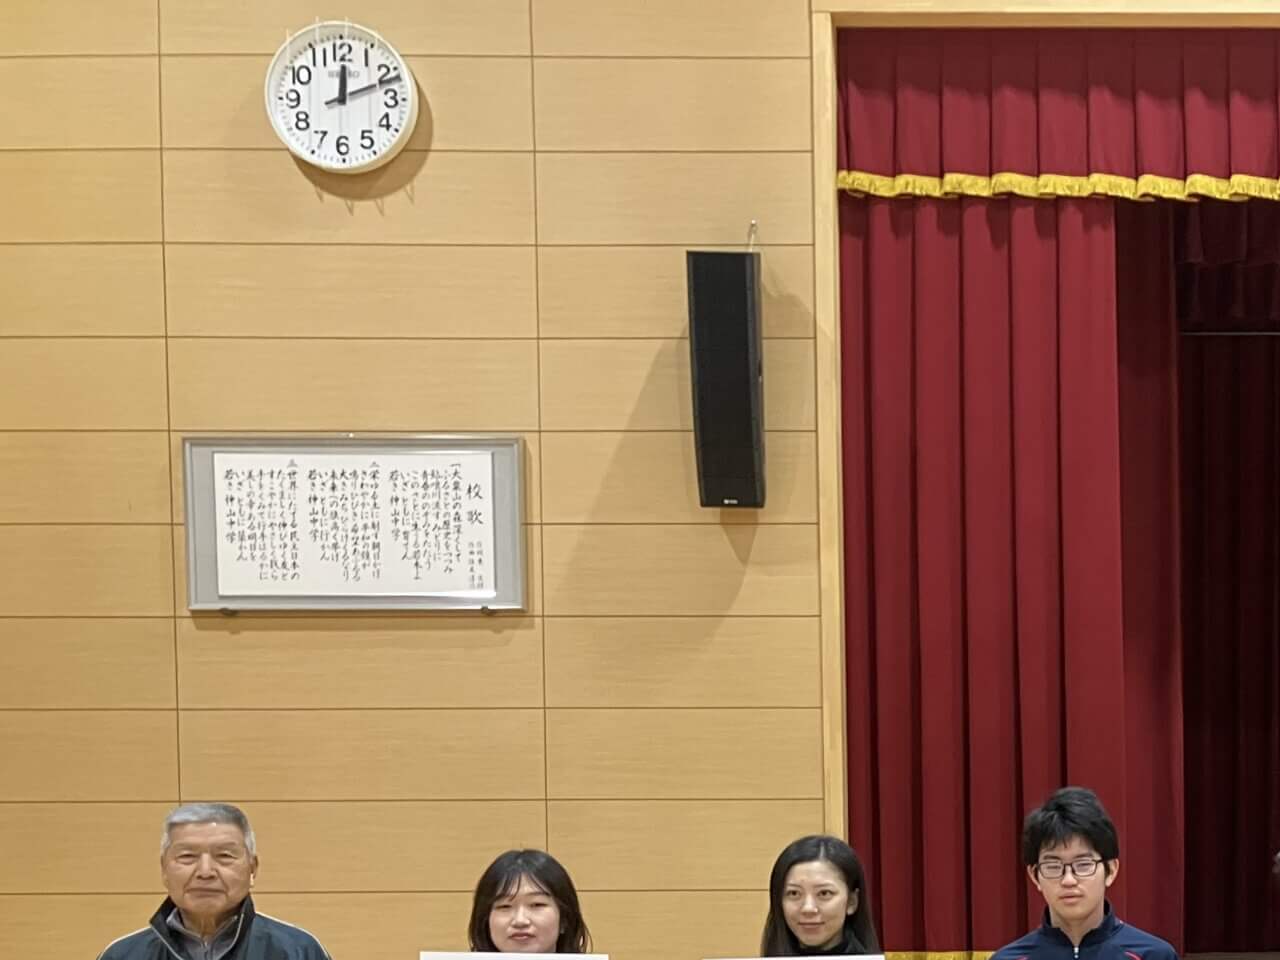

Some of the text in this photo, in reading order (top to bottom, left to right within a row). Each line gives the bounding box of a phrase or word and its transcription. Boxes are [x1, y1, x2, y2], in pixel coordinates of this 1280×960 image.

[311, 47, 327, 67] 11
[333, 42, 352, 62] 12
[292, 65, 312, 85] 10
[377, 63, 391, 84] 2
[286, 88, 300, 109] 9
[384, 88, 399, 109] 3
[295, 111, 310, 131] 8
[378, 112, 392, 131] 4
[313, 130, 328, 149] 7
[335, 135, 349, 156] 6
[360, 129, 375, 149] 5
